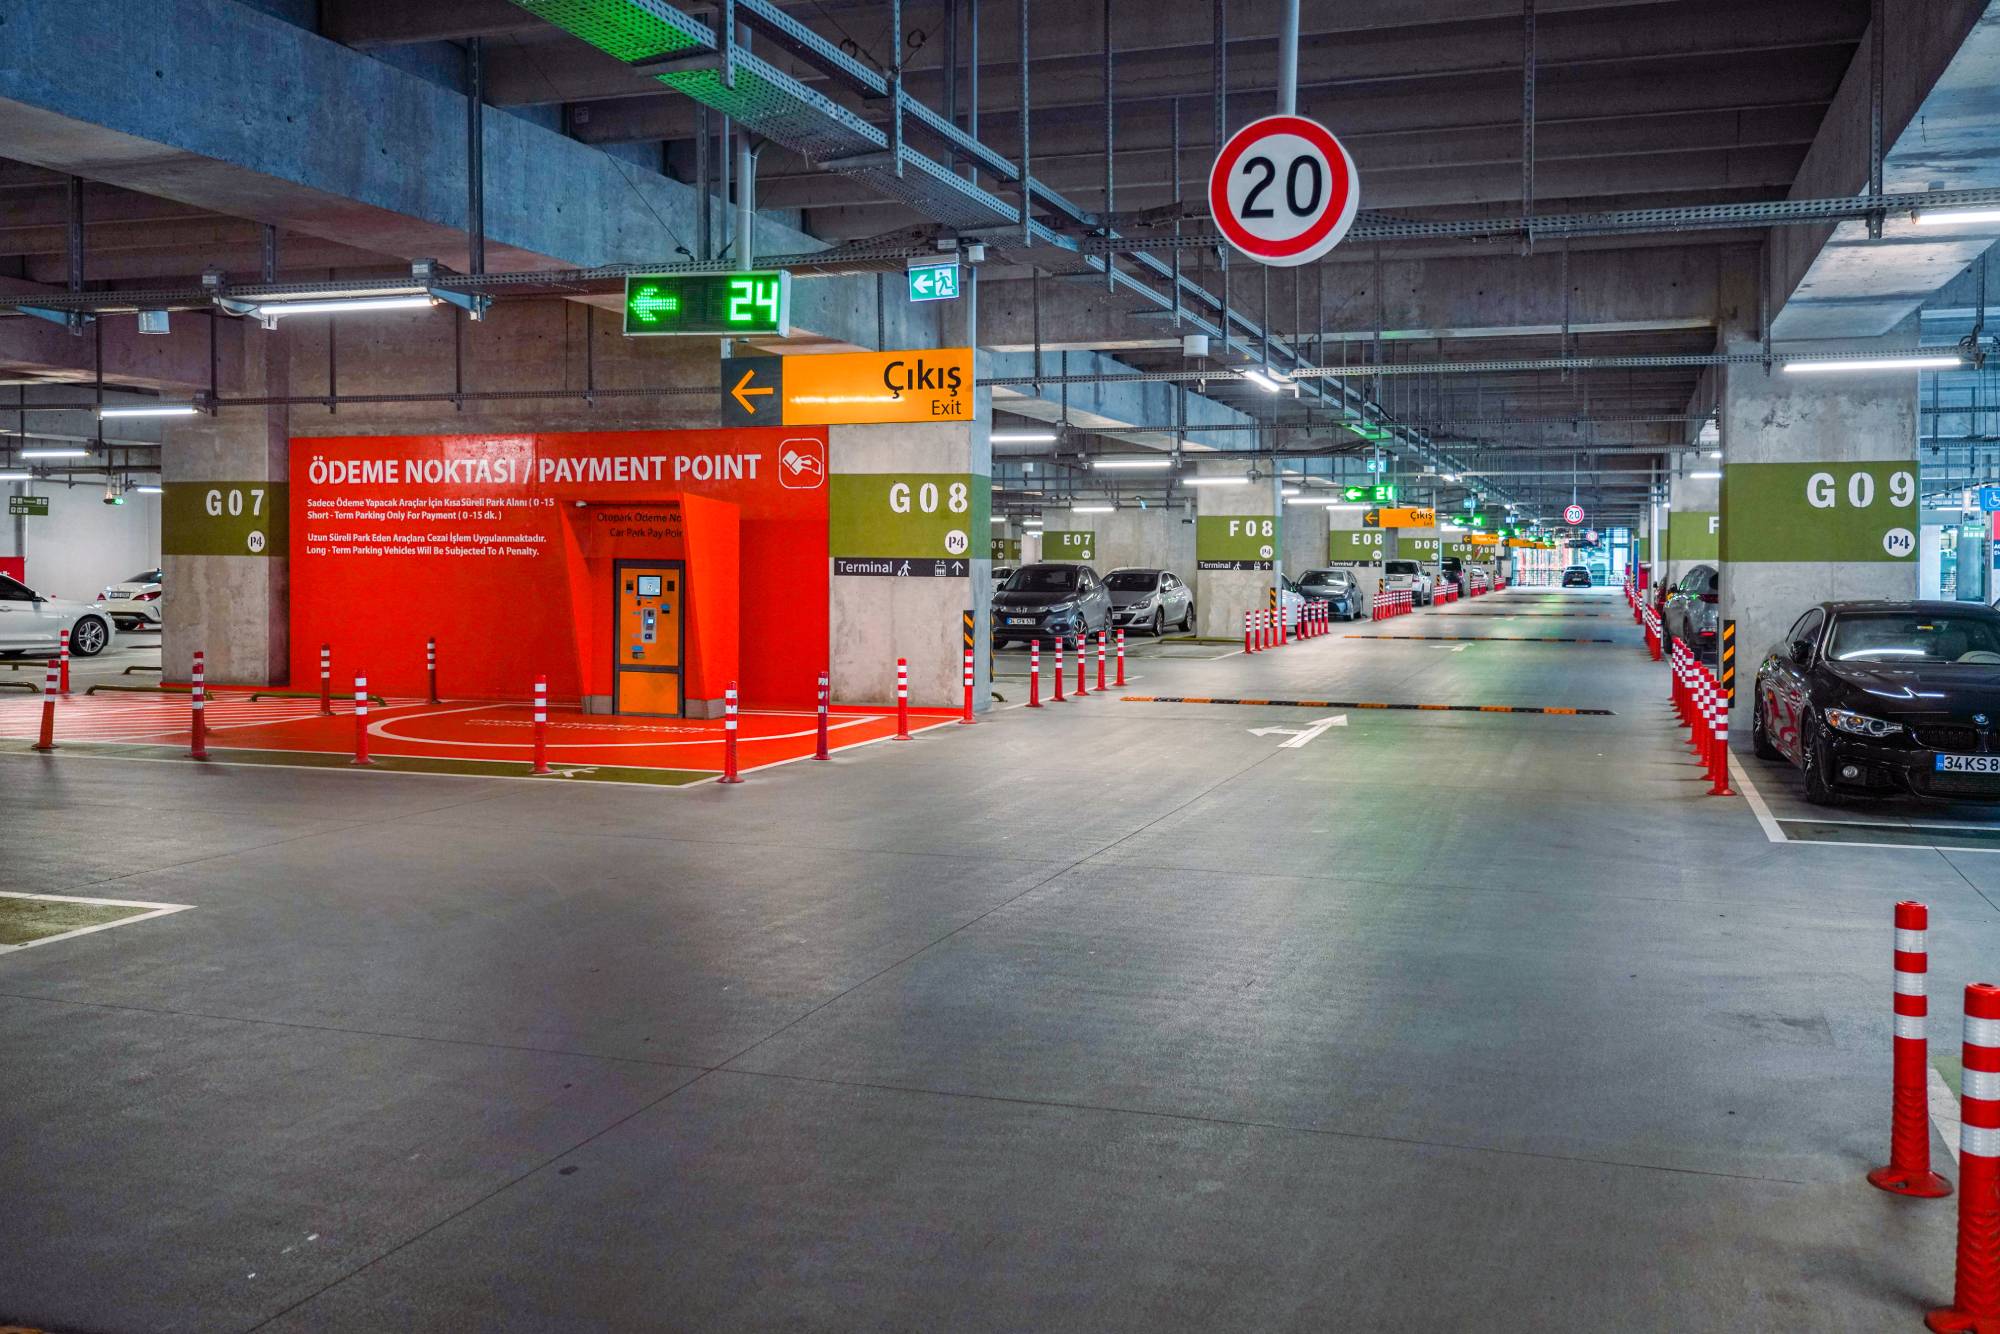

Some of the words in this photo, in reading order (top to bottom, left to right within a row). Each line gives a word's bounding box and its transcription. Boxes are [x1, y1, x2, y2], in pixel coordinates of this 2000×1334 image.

[1241, 155, 1322, 218] 20
[730, 281, 778, 322] 24
[884, 359, 961, 399] Çıkış
[932, 400, 961, 415] Exit
[308, 456, 399, 484] ÖDEME
[405, 459, 516, 484] NOKTASI
[523, 459, 532, 484] /
[539, 456, 666, 482] PAYMENT
[675, 454, 761, 480] POINT
[1807, 471, 1915, 508] G09
[206, 489, 264, 516] G07
[307, 499, 335, 507] Sadece
[336, 497, 364, 507] Ödeme
[365, 498, 397, 508] Yapacak
[399, 498, 427, 508] Araçlar
[428, 497, 442, 508] İçin
[486, 498, 504, 507] Park
[506, 498, 527, 507] Alanı
[889, 482, 968, 513] G08
[307, 511, 329, 520] Short
[335, 511, 354, 520] Term
[355, 511, 385, 521] Parking
[386, 511, 404, 521] Only
[407, 511, 420, 520] For
[421, 511, 456, 521] Payment
[484, 511, 497, 520] dk.
[1568, 510, 1580, 519] 20
[626, 528, 645, 536] Park
[647, 528, 662, 538] Pay
[1229, 520, 1273, 537] F08
[250, 536, 262, 547] P4
[308, 533, 328, 541] Uzun
[329, 533, 351, 541] Süreli
[353, 533, 371, 541] Park
[372, 533, 392, 541] Eden
[393, 533, 425, 543] Araçlara
[427, 533, 448, 541] Cezai
[450, 532, 471, 543] İşlem
[473, 533, 546, 543] Uygulanmaktadır.
[948, 536, 964, 548] P4
[1063, 534, 1091, 546] E07
[1352, 533, 1383, 545] E08
[1887, 536, 1909, 549] P4
[1414, 540, 1439, 549] D08
[307, 546, 326, 555] Long
[332, 546, 351, 554] Term
[353, 546, 383, 556] Parking
[384, 546, 416, 555] Vehicles
[417, 546, 432, 555] Will
[434, 547, 444, 555] Be
[445, 546, 486, 556] Subjected
[487, 547, 497, 555] To
[507, 547, 539, 557] Penalty.
[838, 561, 893, 573] Terminal
[1945, 757, 1962, 770] 34
[1965, 757, 1987, 771] KS
